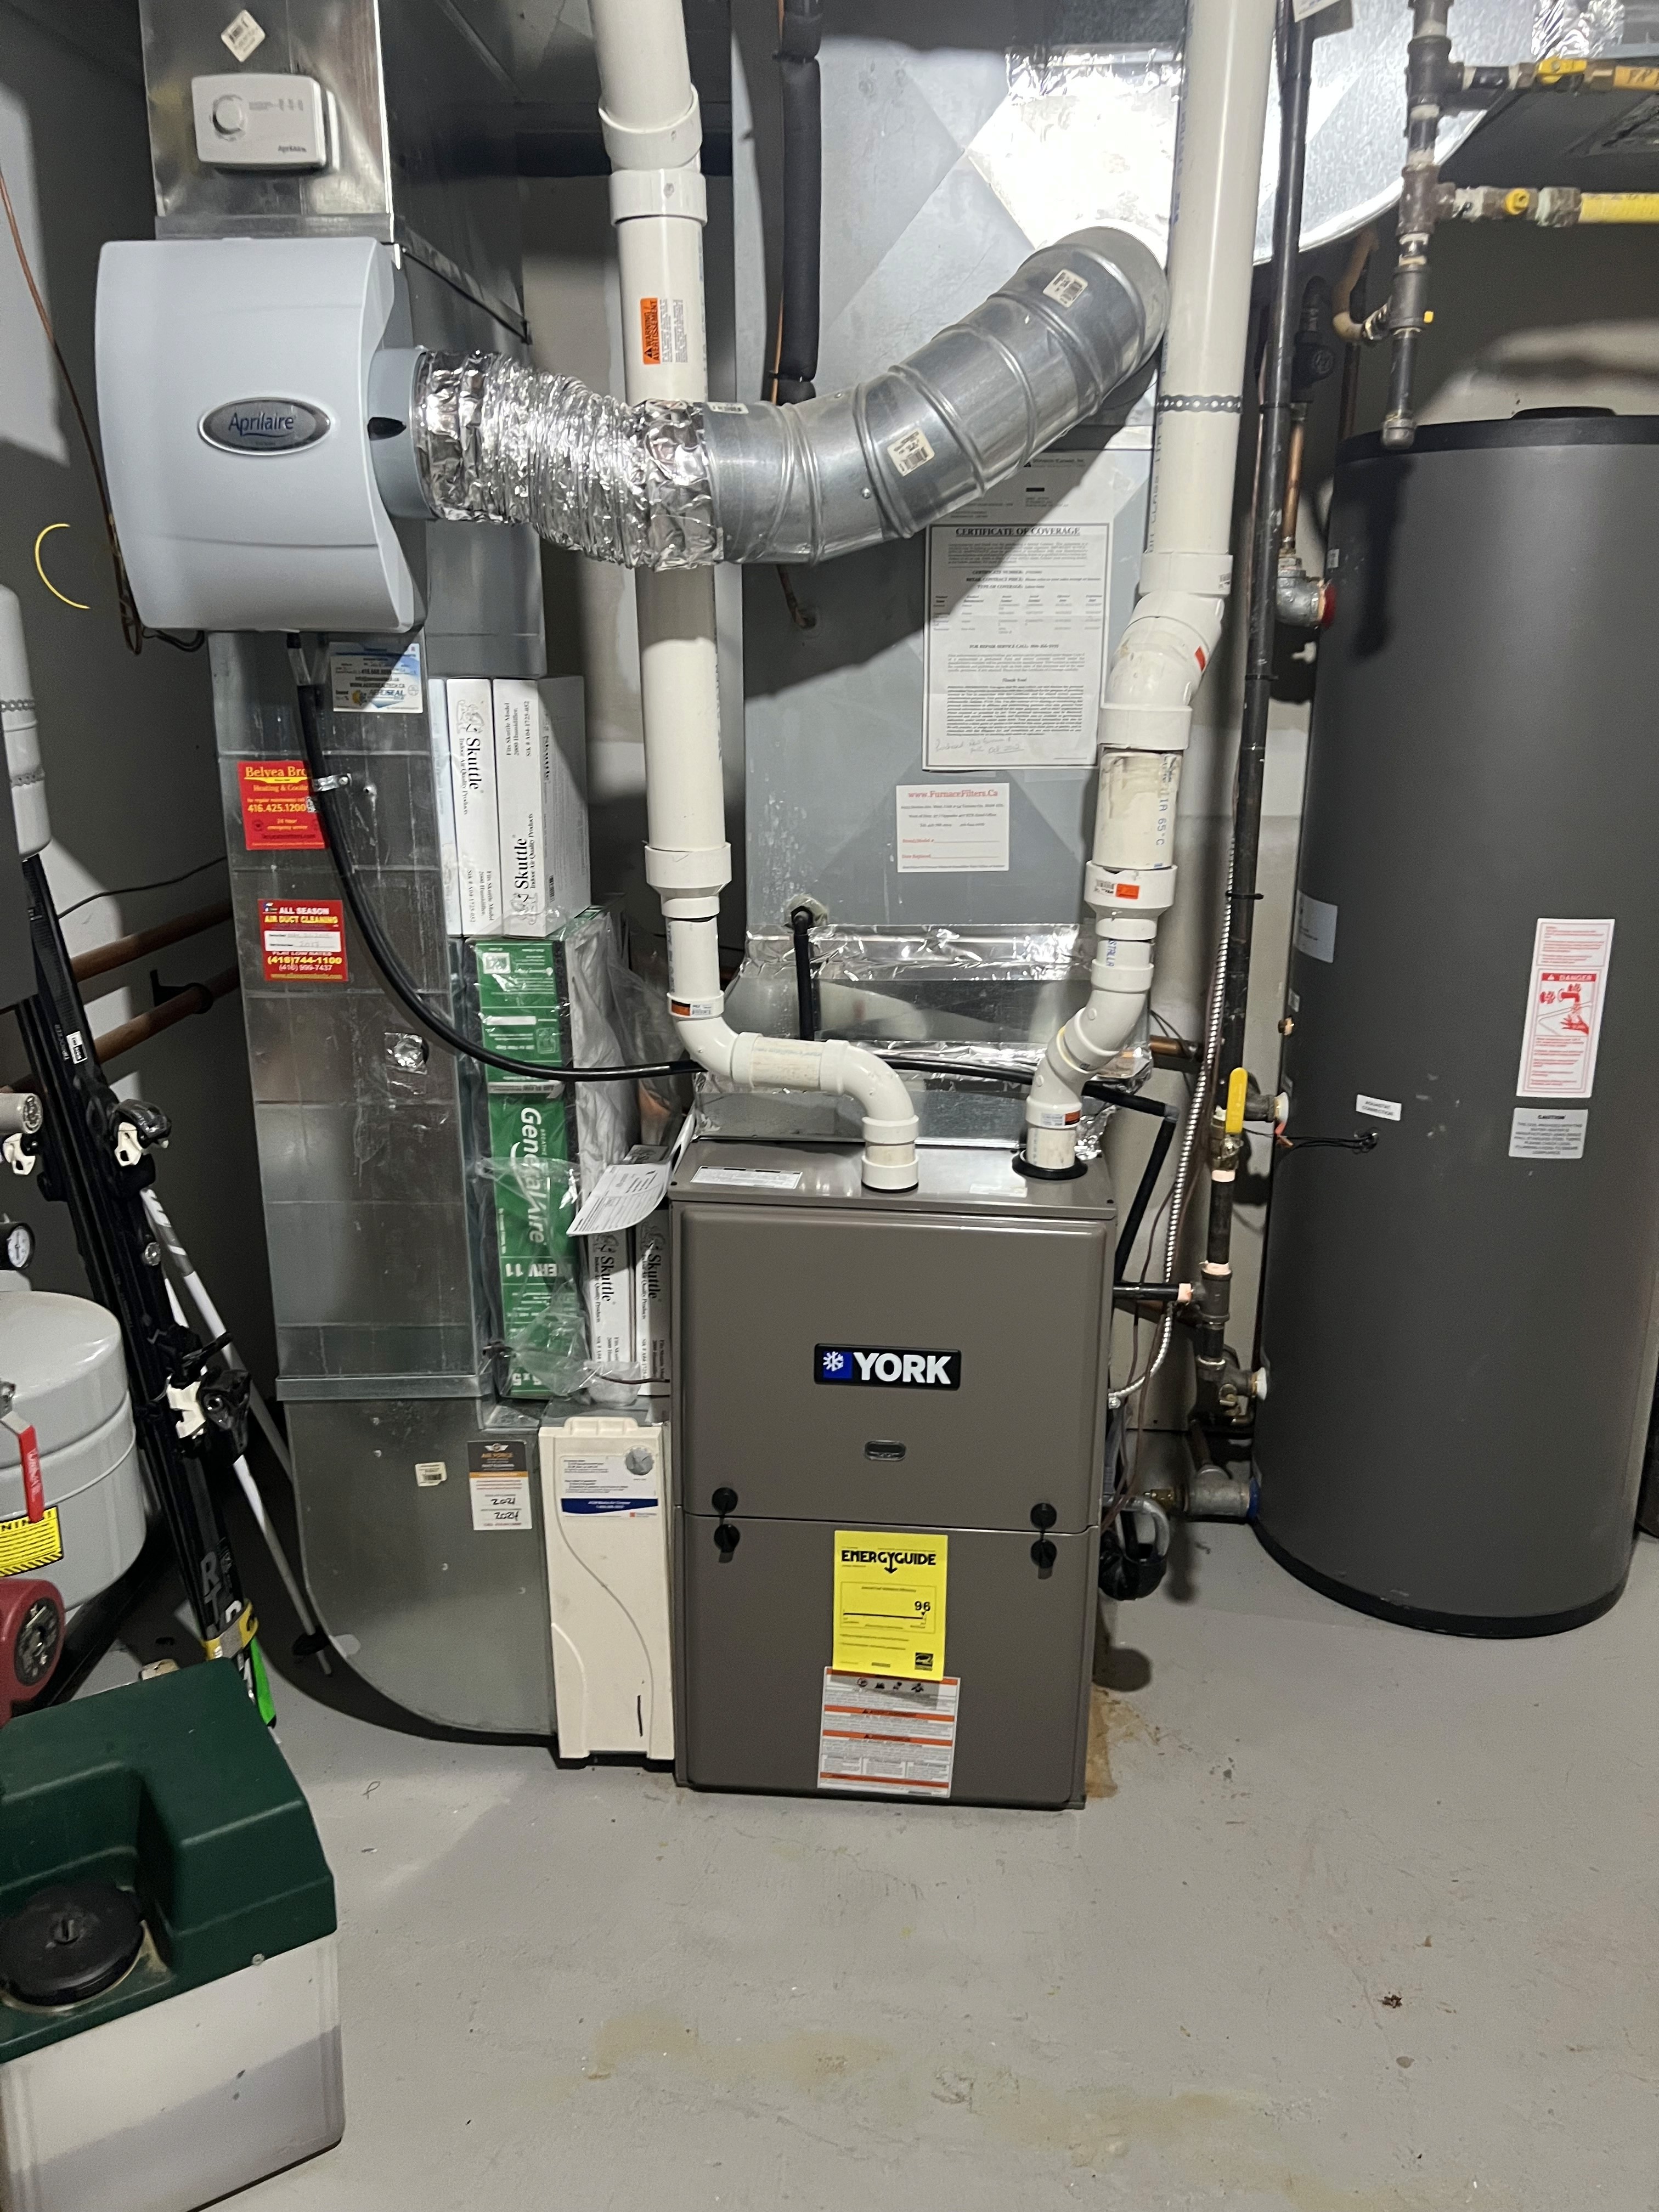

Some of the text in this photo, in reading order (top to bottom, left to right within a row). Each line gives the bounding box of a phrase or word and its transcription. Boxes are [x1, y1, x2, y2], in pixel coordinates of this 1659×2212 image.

[228, 411, 294, 437] Aprilaire
[955, 527, 1081, 536] CERTIFICATE OF COVERAGE
[466, 737, 482, 790] Skuttle
[514, 838, 529, 889] Skuttle
[296, 907, 330, 915] SEASON
[279, 915, 300, 923] DUCT
[300, 916, 339, 924] CLEANING
[505, 1263, 524, 1277] 11
[648, 1254, 662, 1299] Skuttle
[601, 1256, 614, 1301] Skuttle
[853, 1352, 952, 1385] YORK
[490, 1497, 516, 1505] 2021
[841, 1550, 936, 1566] ENERGYGUIDE
[915, 1601, 931, 1612] 96
